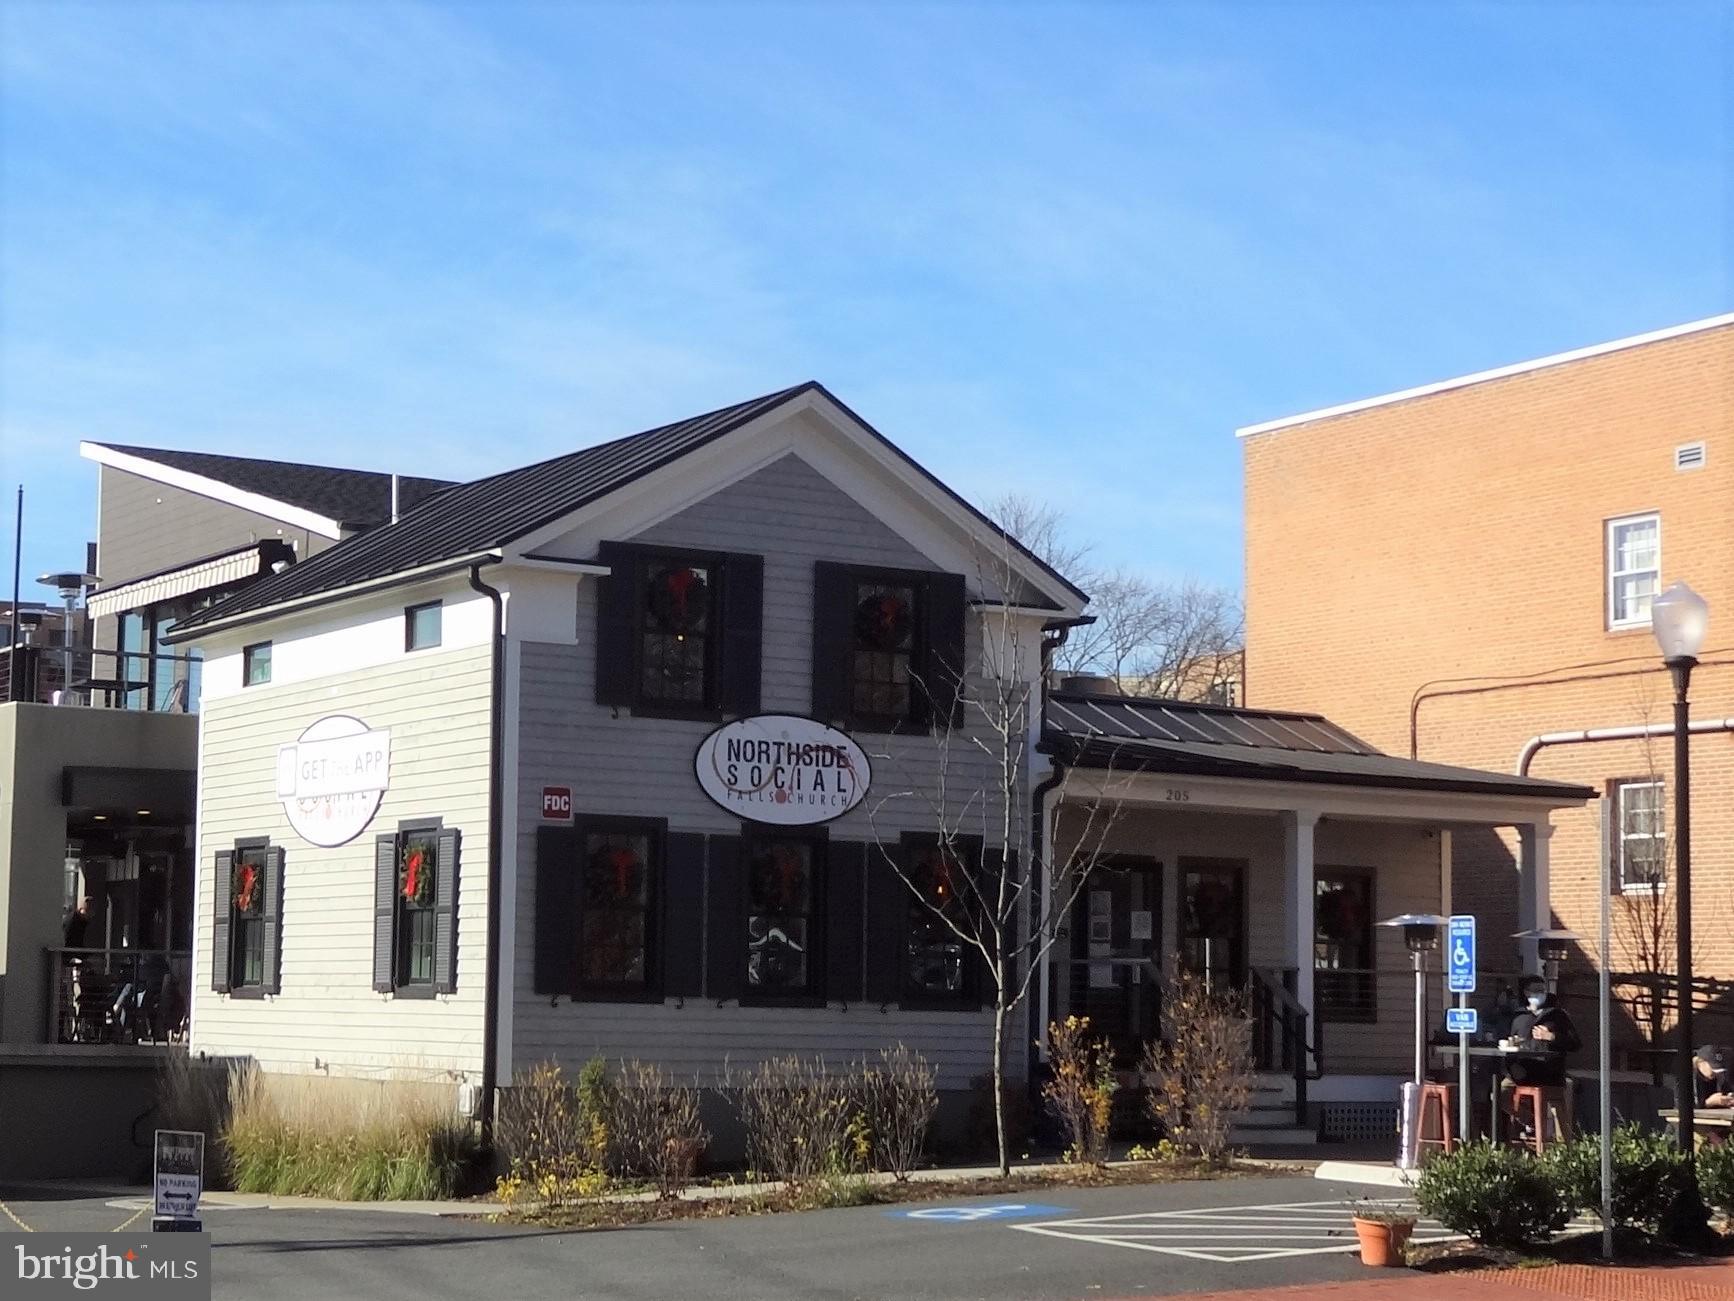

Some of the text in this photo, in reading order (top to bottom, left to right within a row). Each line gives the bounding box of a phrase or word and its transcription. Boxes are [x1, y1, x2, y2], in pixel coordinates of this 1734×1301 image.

[727, 738, 847, 769] NORTHSIDE
[301, 758, 328, 780] GET
[354, 750, 384, 775] APP
[727, 764, 847, 793] SOCIAL
[544, 795, 569, 811] FDC
[727, 790, 847, 806] FALLS CHURCH
[1166, 789, 1189, 801] 205
